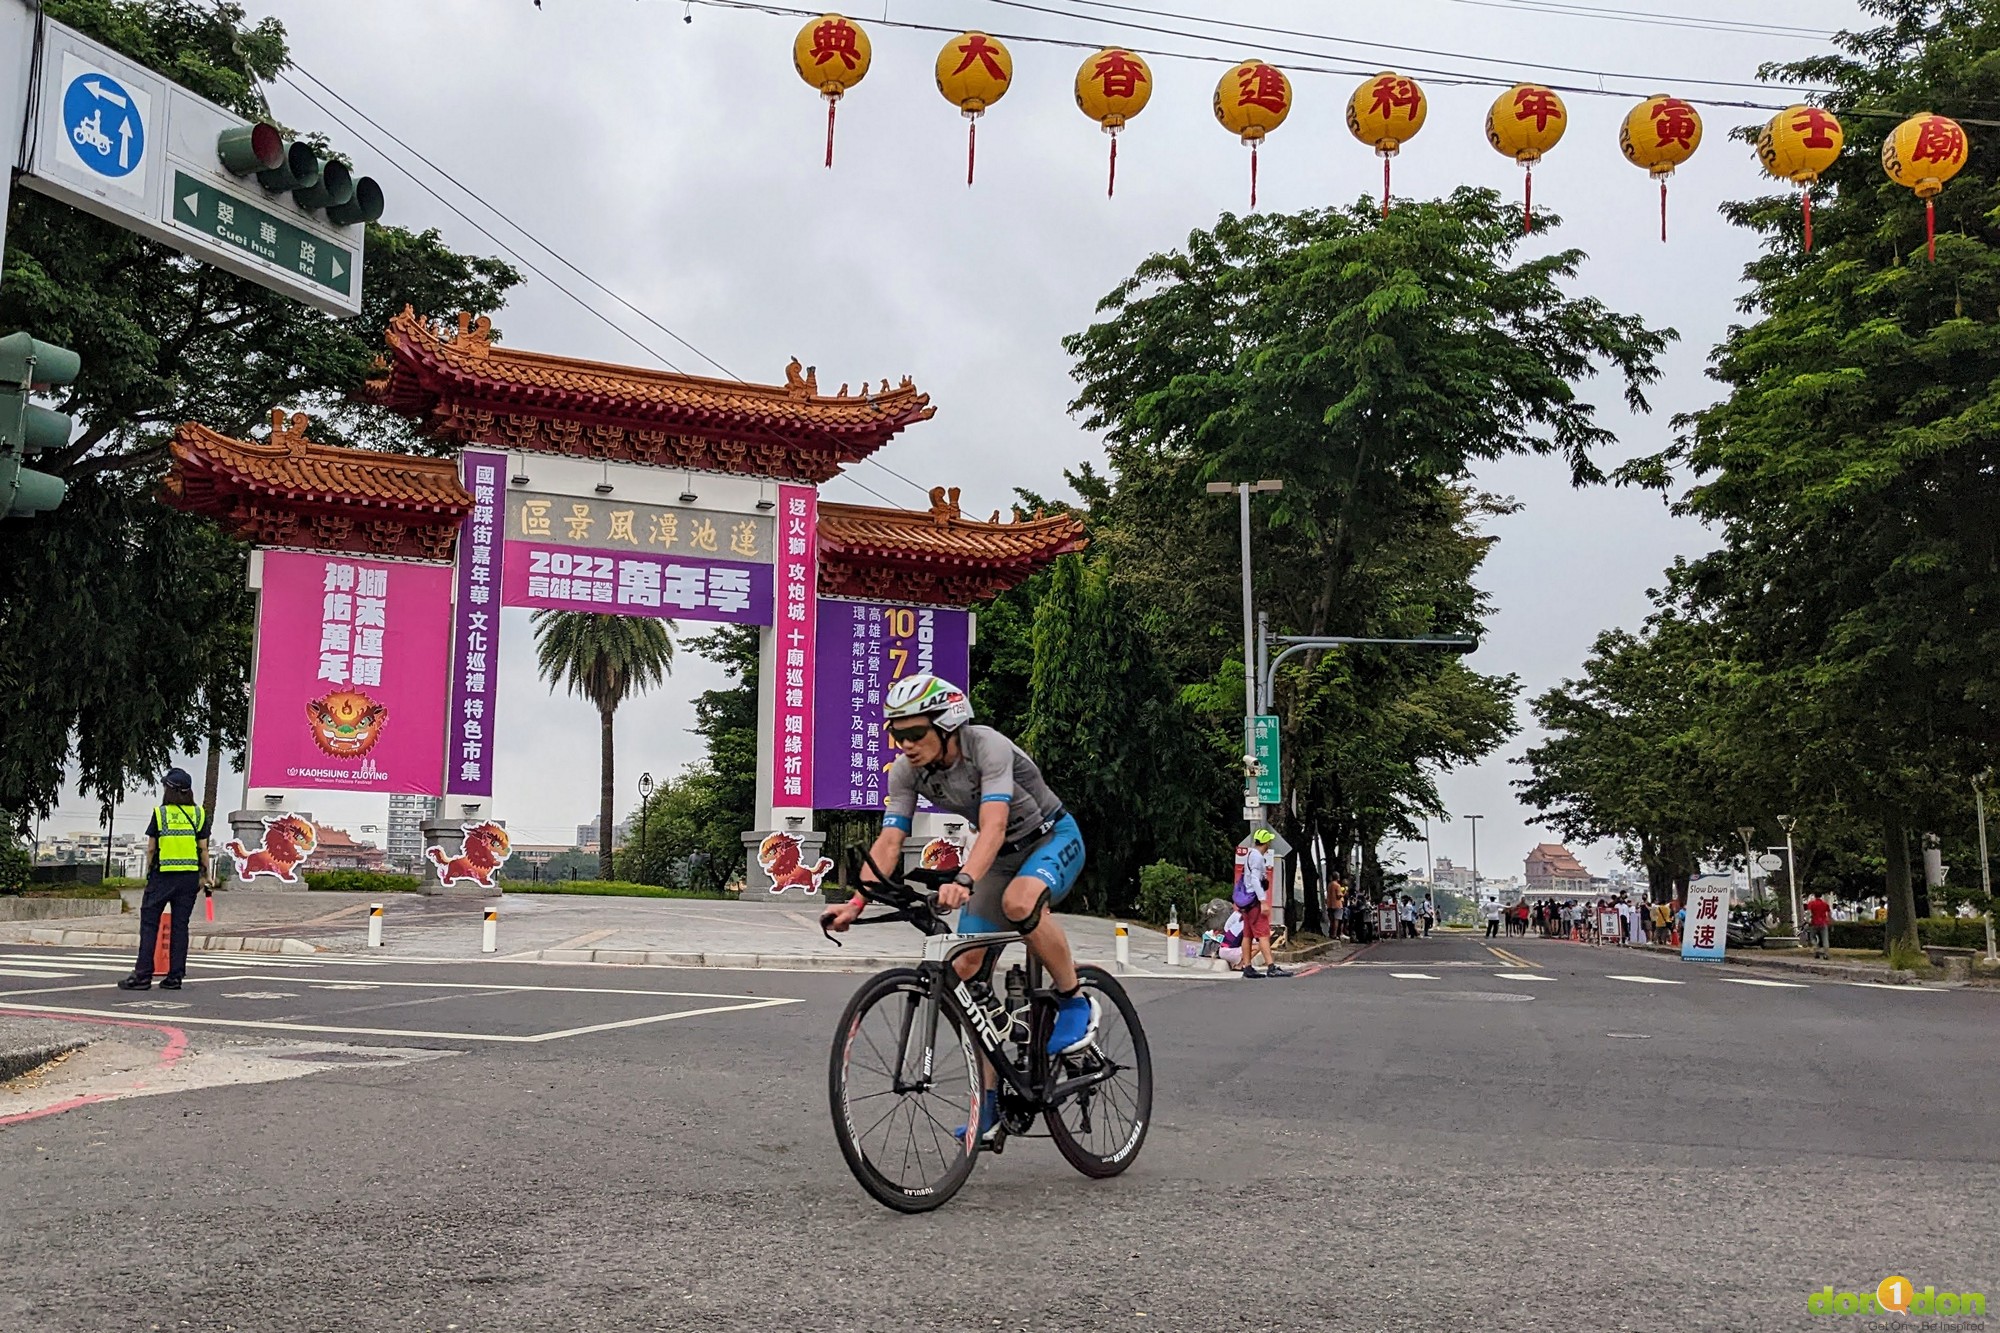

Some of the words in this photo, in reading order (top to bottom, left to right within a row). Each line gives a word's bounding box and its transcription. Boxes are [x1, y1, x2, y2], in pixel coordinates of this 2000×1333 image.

[808, 18, 862, 71] 典
[951, 35, 1008, 82] 大
[1090, 50, 1148, 99] 香
[1236, 63, 1288, 114] 進
[1367, 75, 1422, 122] 科
[1512, 86, 1562, 133] 年
[1649, 97, 1697, 151] 寅
[1910, 115, 1964, 166] 廟
[216, 225, 247, 247] Cuei
[251, 240, 276, 260] hua
[299, 261, 316, 277] Rd.
[217, 200, 316, 265] 翠華路
[469, 465, 495, 606] 國際踩街嘉年華
[528, 575, 613, 604] 高雄左營
[529, 550, 614, 580] 2022
[617, 559, 750, 613] 萬年季
[787, 563, 806, 621] 攻炮城
[318, 562, 354, 685] 神佑萬年
[352, 566, 388, 687] 獅來運轉
[465, 611, 489, 693] 文化巡禮
[785, 628, 805, 708] 十廟巡禮
[850, 605, 866, 805] 環潭鄰近廟宇及週邊地點
[866, 607, 881, 806] 高雄左營孔廟、萬年縣公園
[460, 698, 484, 782] 特色市集
[783, 714, 803, 796] 姻緣祈福
[299, 768, 349, 778] KAOHSIUNG
[351, 770, 388, 780] ZUOYING
[1690, 885, 1706, 894] Slow
[1707, 885, 1728, 894] Down
[1692, 895, 1719, 950] 減速
[953, 981, 999, 1052] BMC
